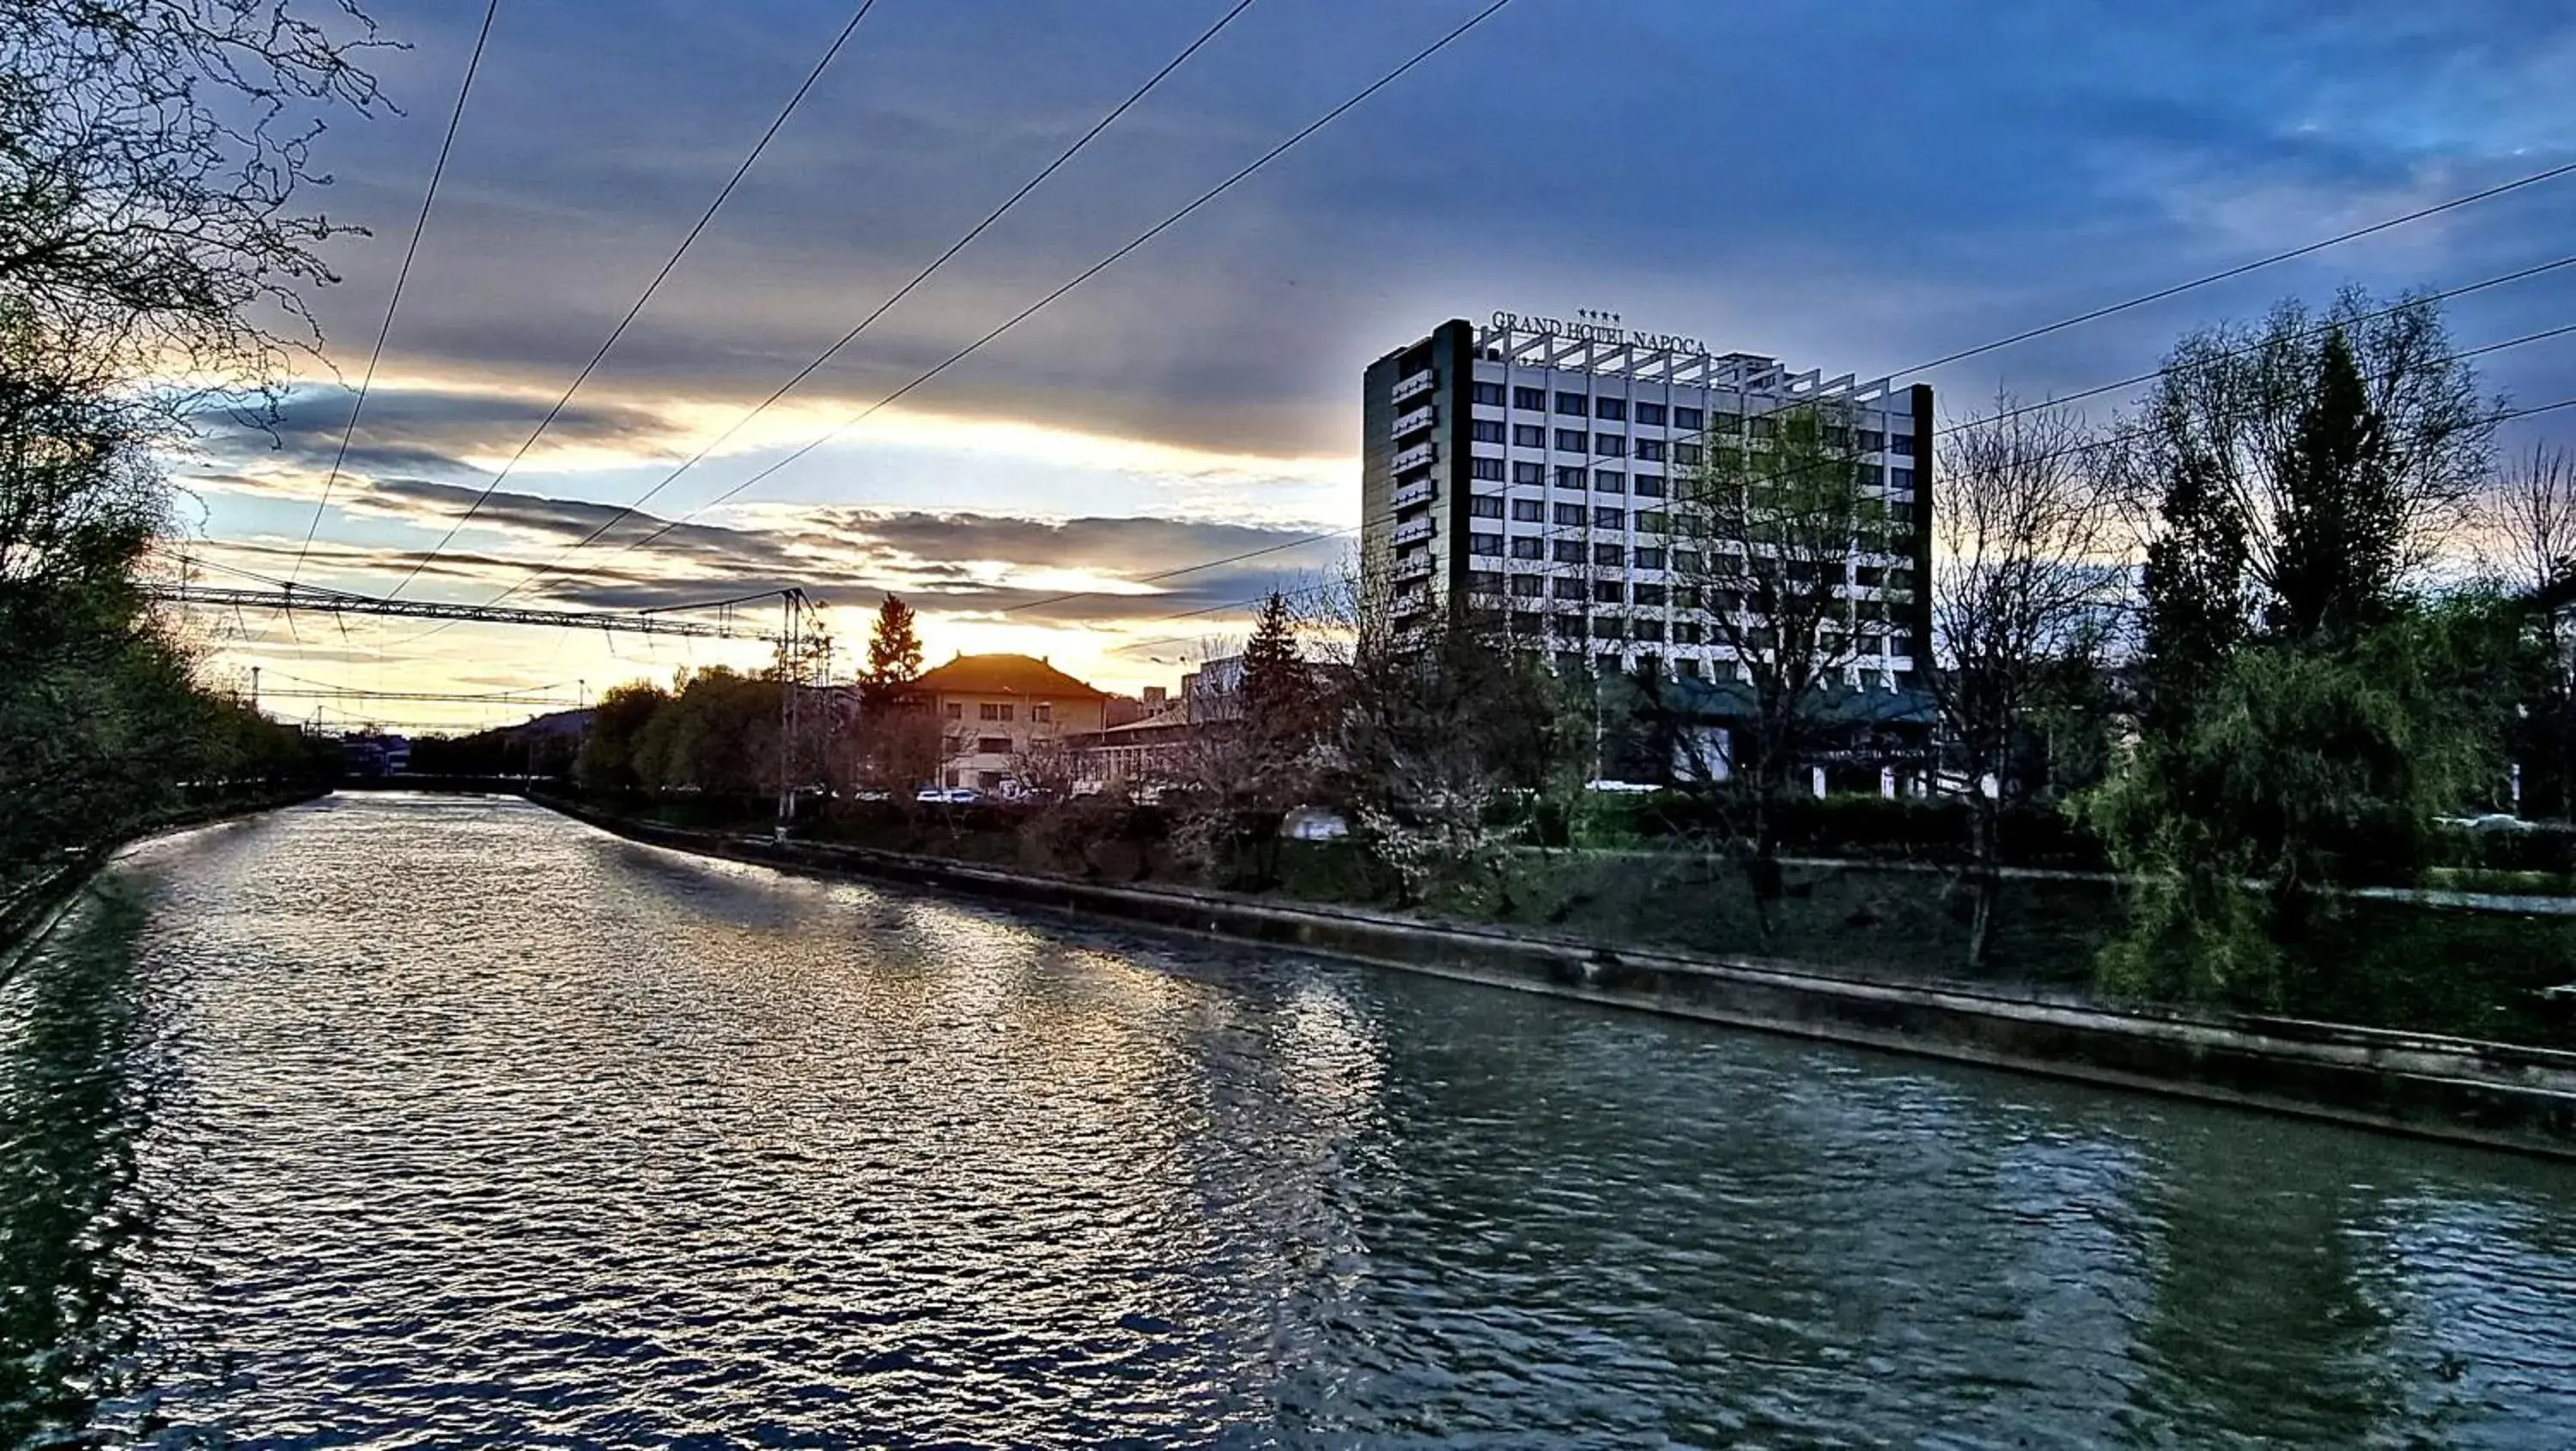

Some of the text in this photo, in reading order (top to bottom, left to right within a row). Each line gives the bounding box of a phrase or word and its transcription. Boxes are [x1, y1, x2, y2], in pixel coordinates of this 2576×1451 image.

[1492, 311, 1707, 355] GRAND HOTEL NAPOCA
